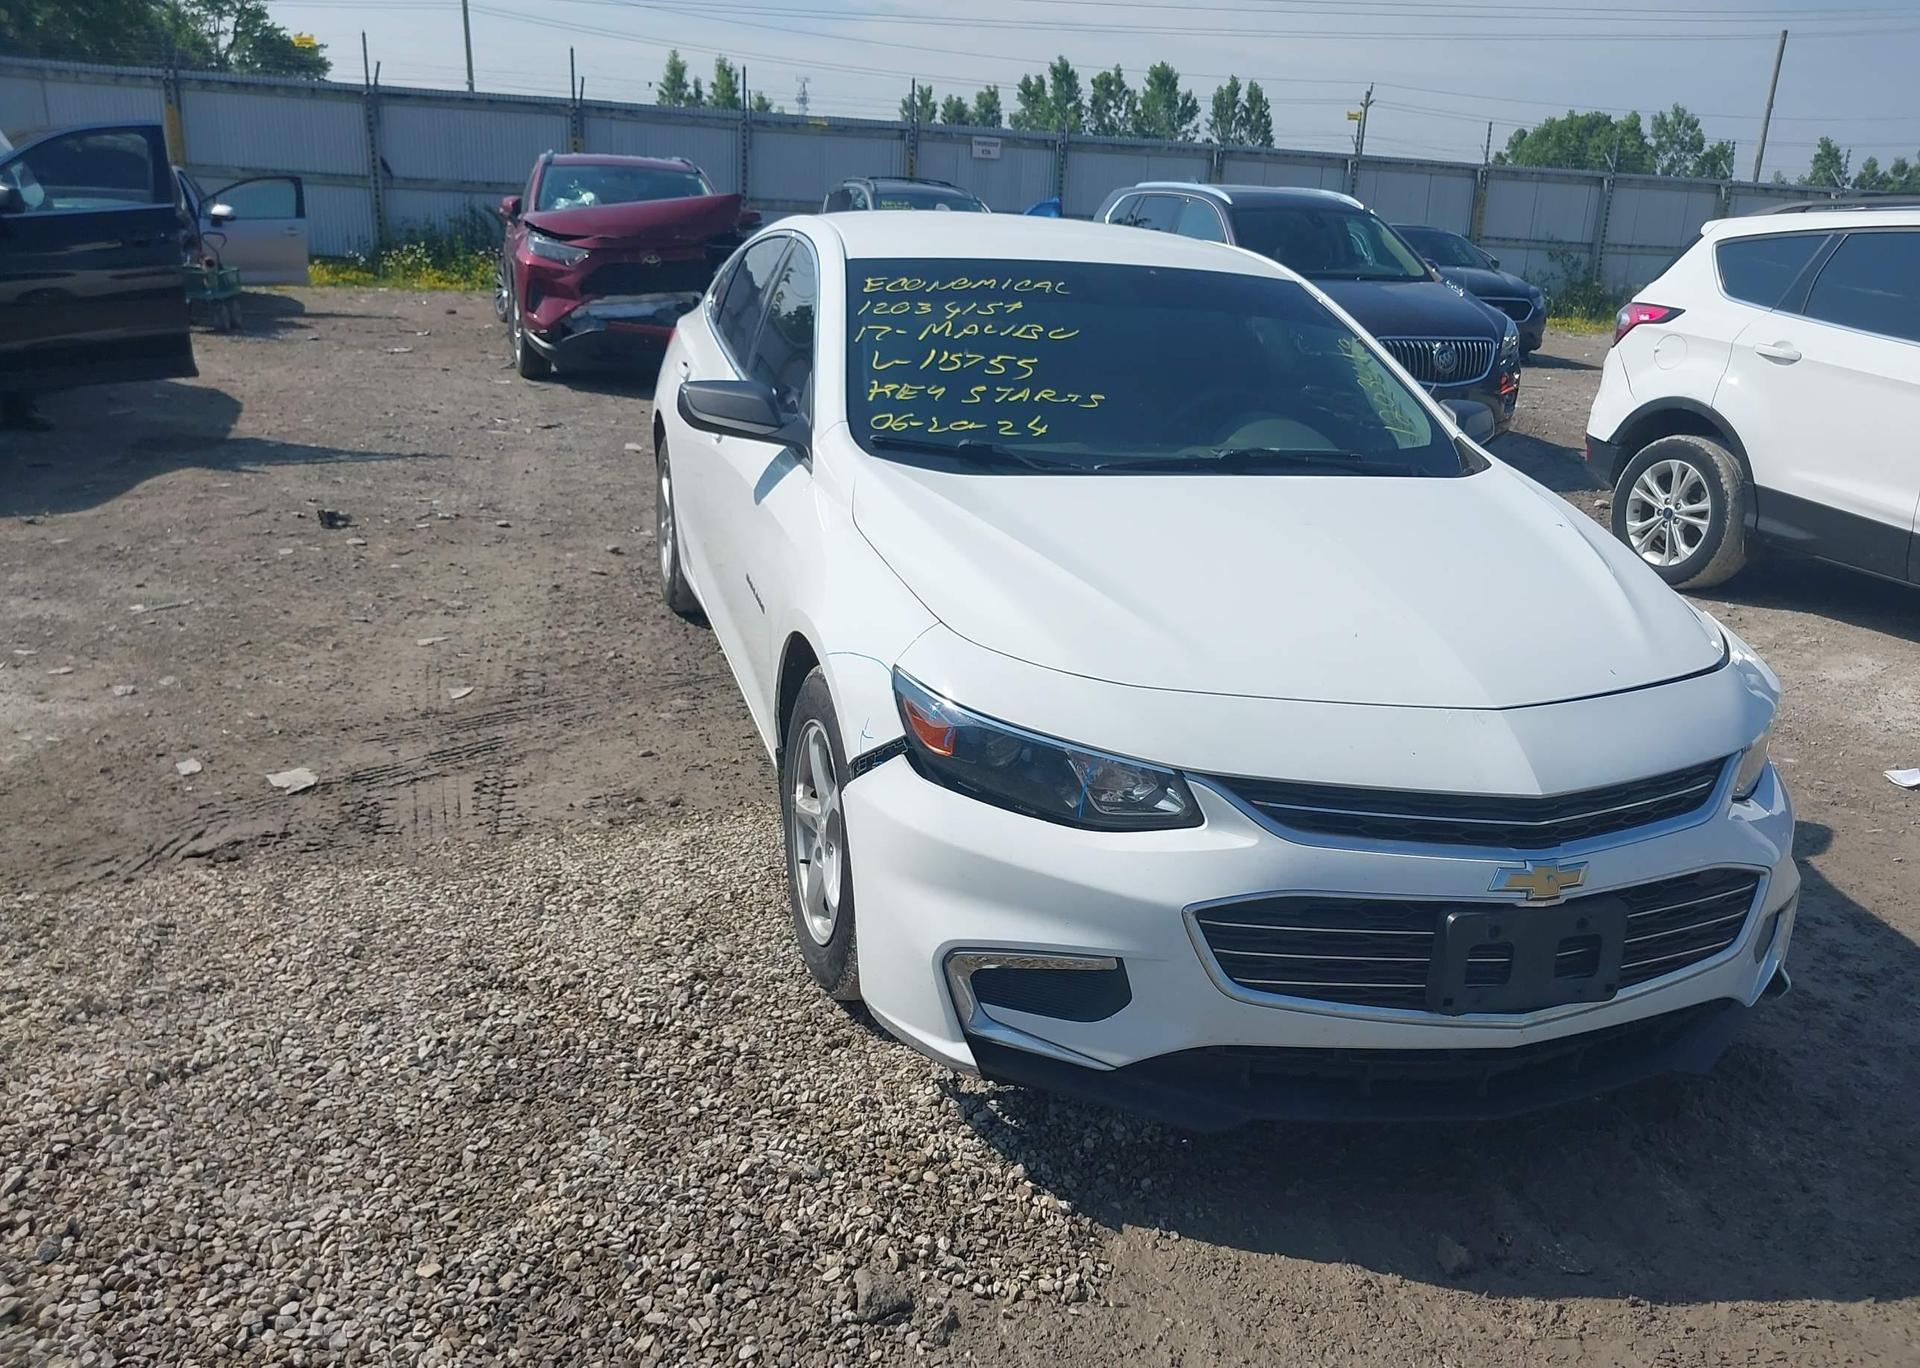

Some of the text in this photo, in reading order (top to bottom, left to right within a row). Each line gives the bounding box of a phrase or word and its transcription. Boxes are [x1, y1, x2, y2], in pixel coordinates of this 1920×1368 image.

[863, 277, 1072, 295] ECONOMICAL
[867, 379, 1105, 408] KEY STARTS
